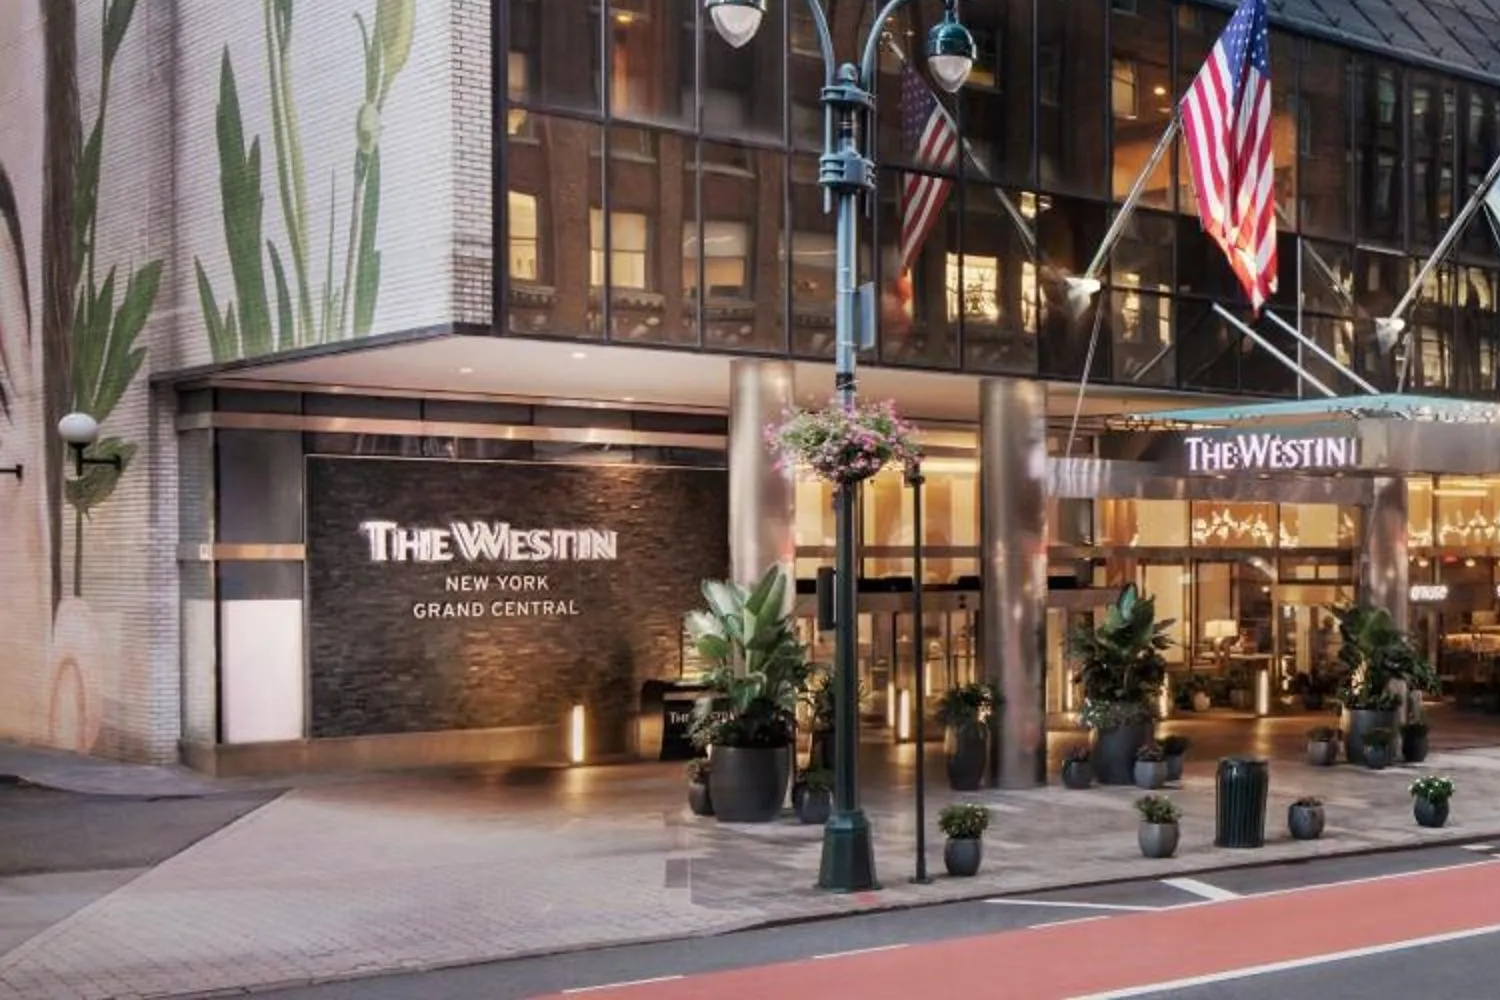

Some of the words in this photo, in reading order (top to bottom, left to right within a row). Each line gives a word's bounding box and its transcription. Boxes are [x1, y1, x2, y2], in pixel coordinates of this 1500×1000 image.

[1184, 437, 1235, 471] THE
[1237, 434, 1346, 469] WESTIN
[361, 521, 454, 562] THE
[451, 521, 618, 561] WESTIN
[445, 576, 489, 592] NEW
[497, 575, 550, 591] YORK
[413, 602, 484, 619] GRAND
[491, 600, 580, 617] CENTRAL
